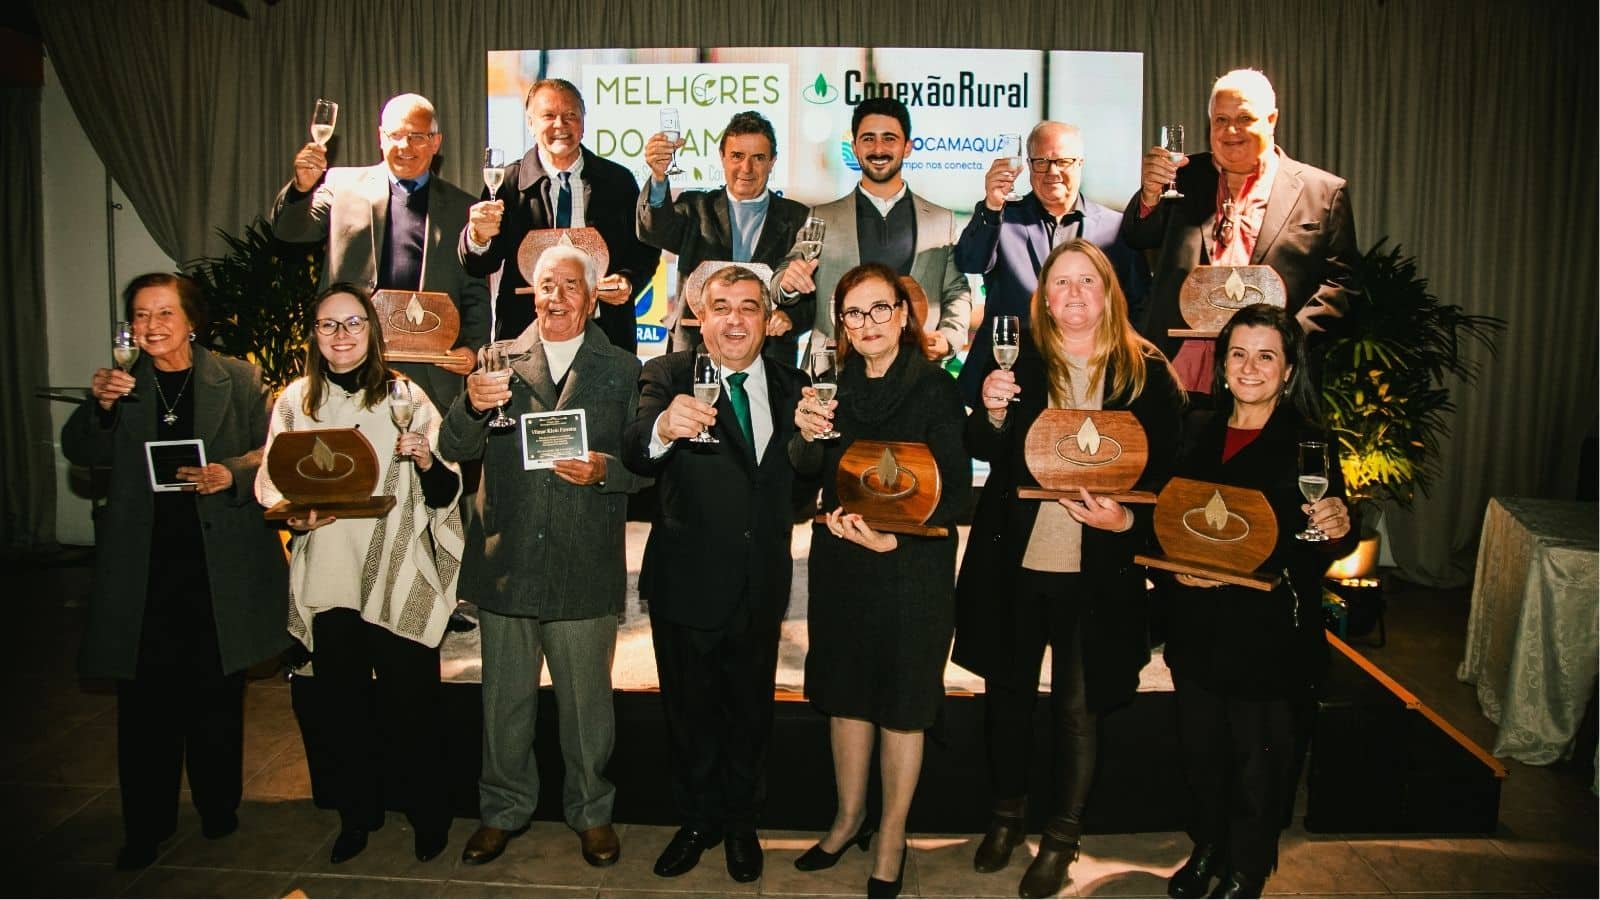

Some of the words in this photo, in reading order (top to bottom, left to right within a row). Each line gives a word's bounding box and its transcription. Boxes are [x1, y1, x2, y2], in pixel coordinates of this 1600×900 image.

[596, 74, 780, 106] MELHORES
[596, 129, 644, 157] DO
[903, 162, 924, 171] mpo
[926, 162, 943, 170] nos
[636, 327, 660, 341] RAL
